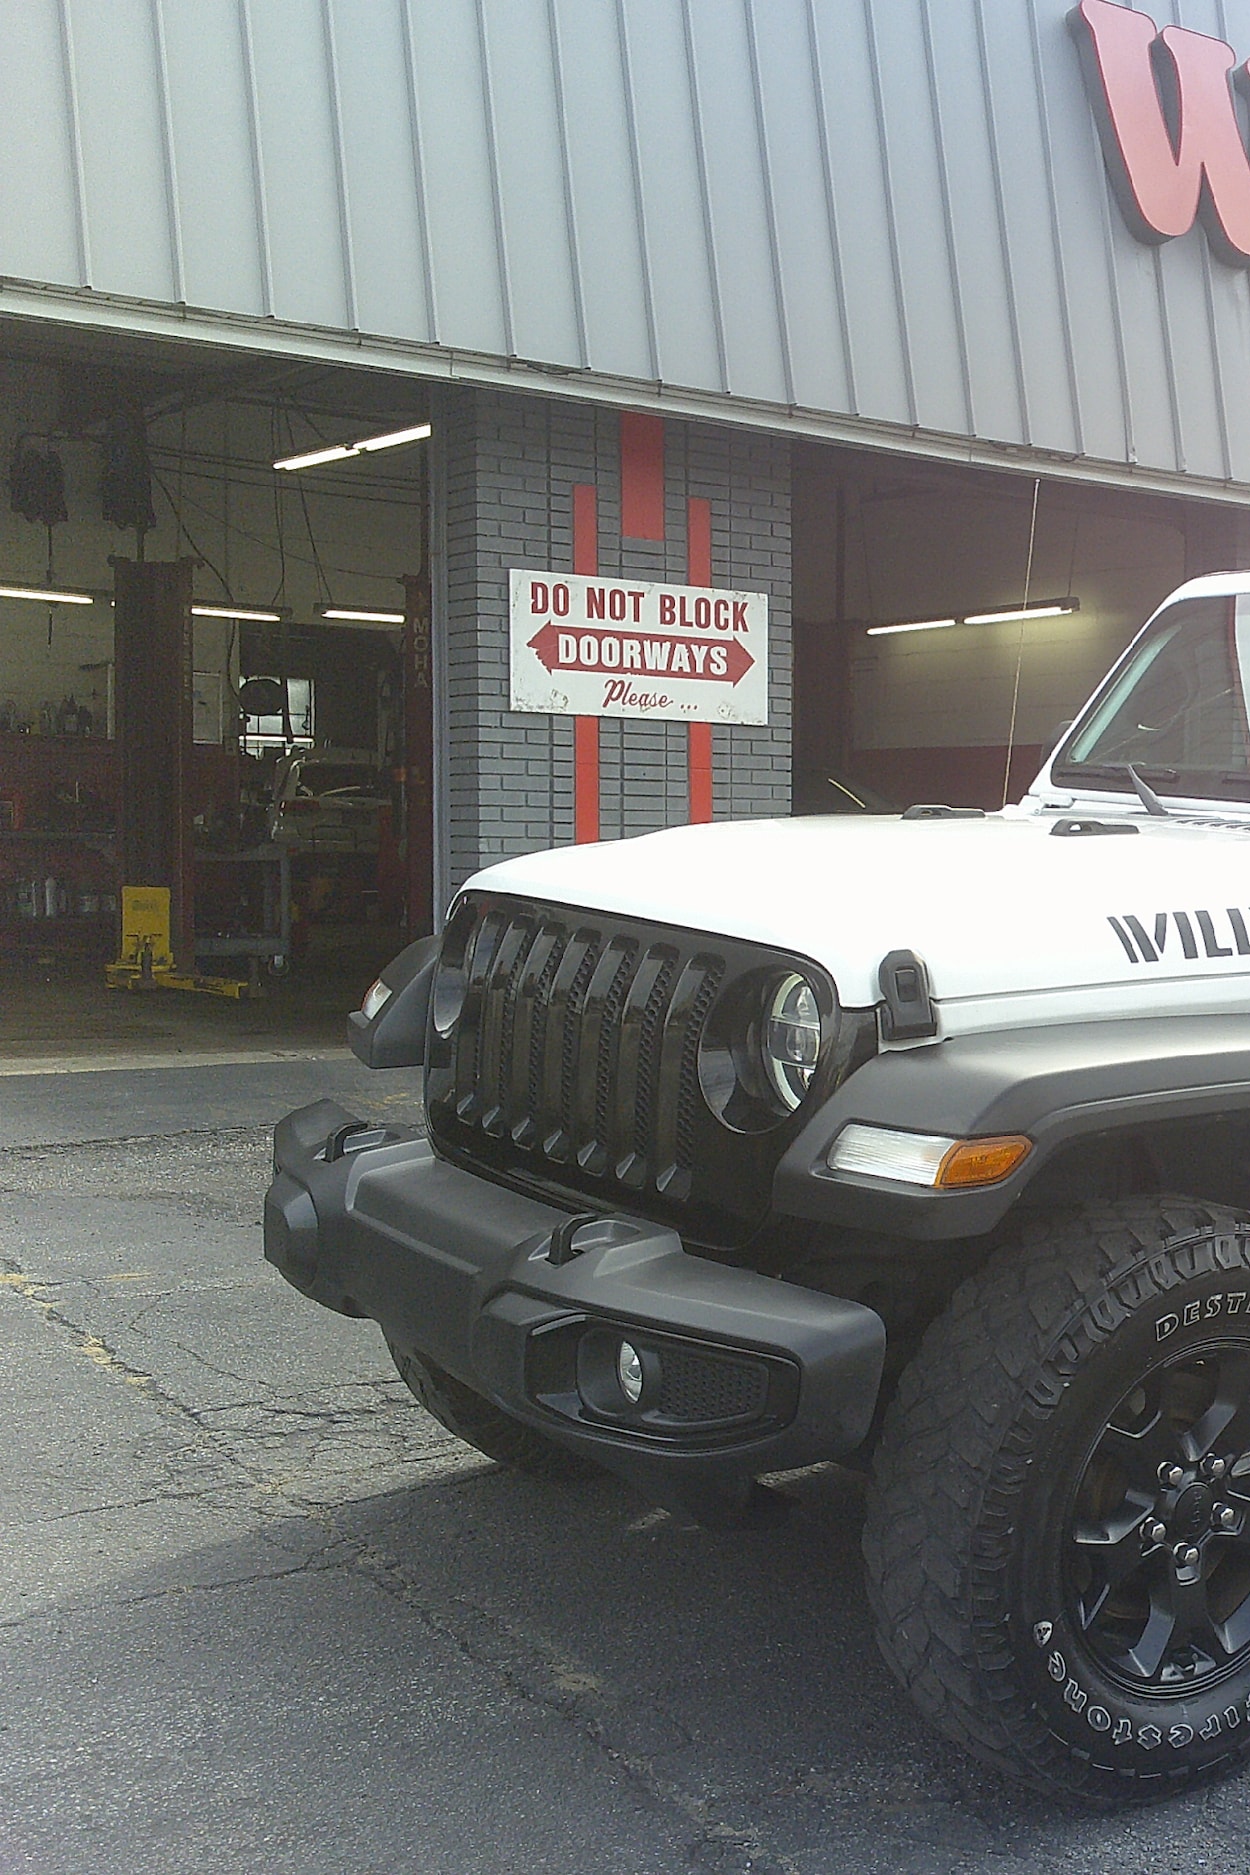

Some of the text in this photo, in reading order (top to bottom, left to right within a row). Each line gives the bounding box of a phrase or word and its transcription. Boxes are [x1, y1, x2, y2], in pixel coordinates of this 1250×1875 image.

[530, 581, 750, 633] DO NOT BLOCK
[557, 632, 729, 677] DOORWAYS
[601, 678, 675, 708] Please
